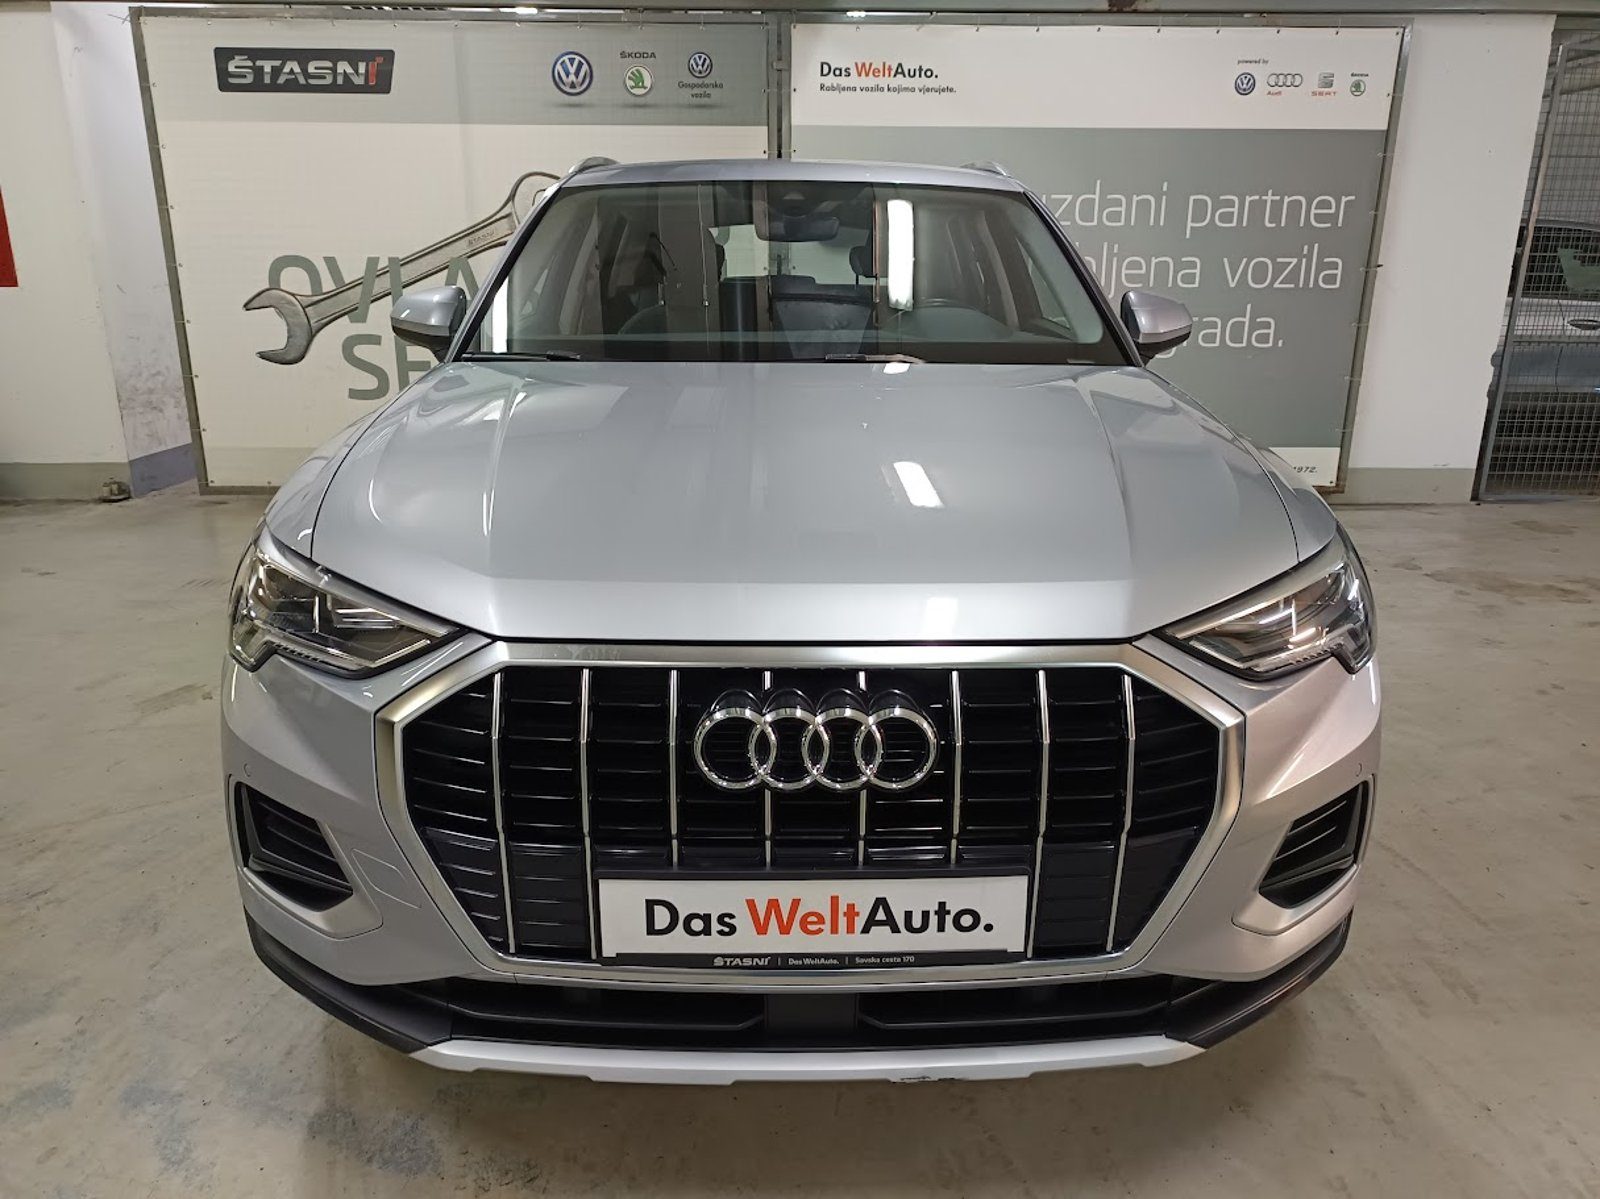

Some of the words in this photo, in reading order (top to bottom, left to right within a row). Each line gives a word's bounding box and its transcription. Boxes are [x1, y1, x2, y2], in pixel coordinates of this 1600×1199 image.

[619, 51, 657, 59] ŠKODA
[820, 61, 851, 77] Das
[854, 61, 939, 79] WeltAuto.
[677, 80, 724, 90] Gospodarska
[820, 83, 857, 94] Rabljena
[860, 84, 885, 93] vozila
[887, 84, 916, 95] kojima
[918, 85, 957, 95] vjerujete.
[690, 91, 712, 99] vozila
[1185, 189, 1356, 239] partner
[1223, 243, 1343, 289] vozila
[645, 898, 738, 937] Das
[745, 895, 995, 936] WeltAuto.
[855, 956, 880, 964] Savska
[902, 955, 915, 963] 170
